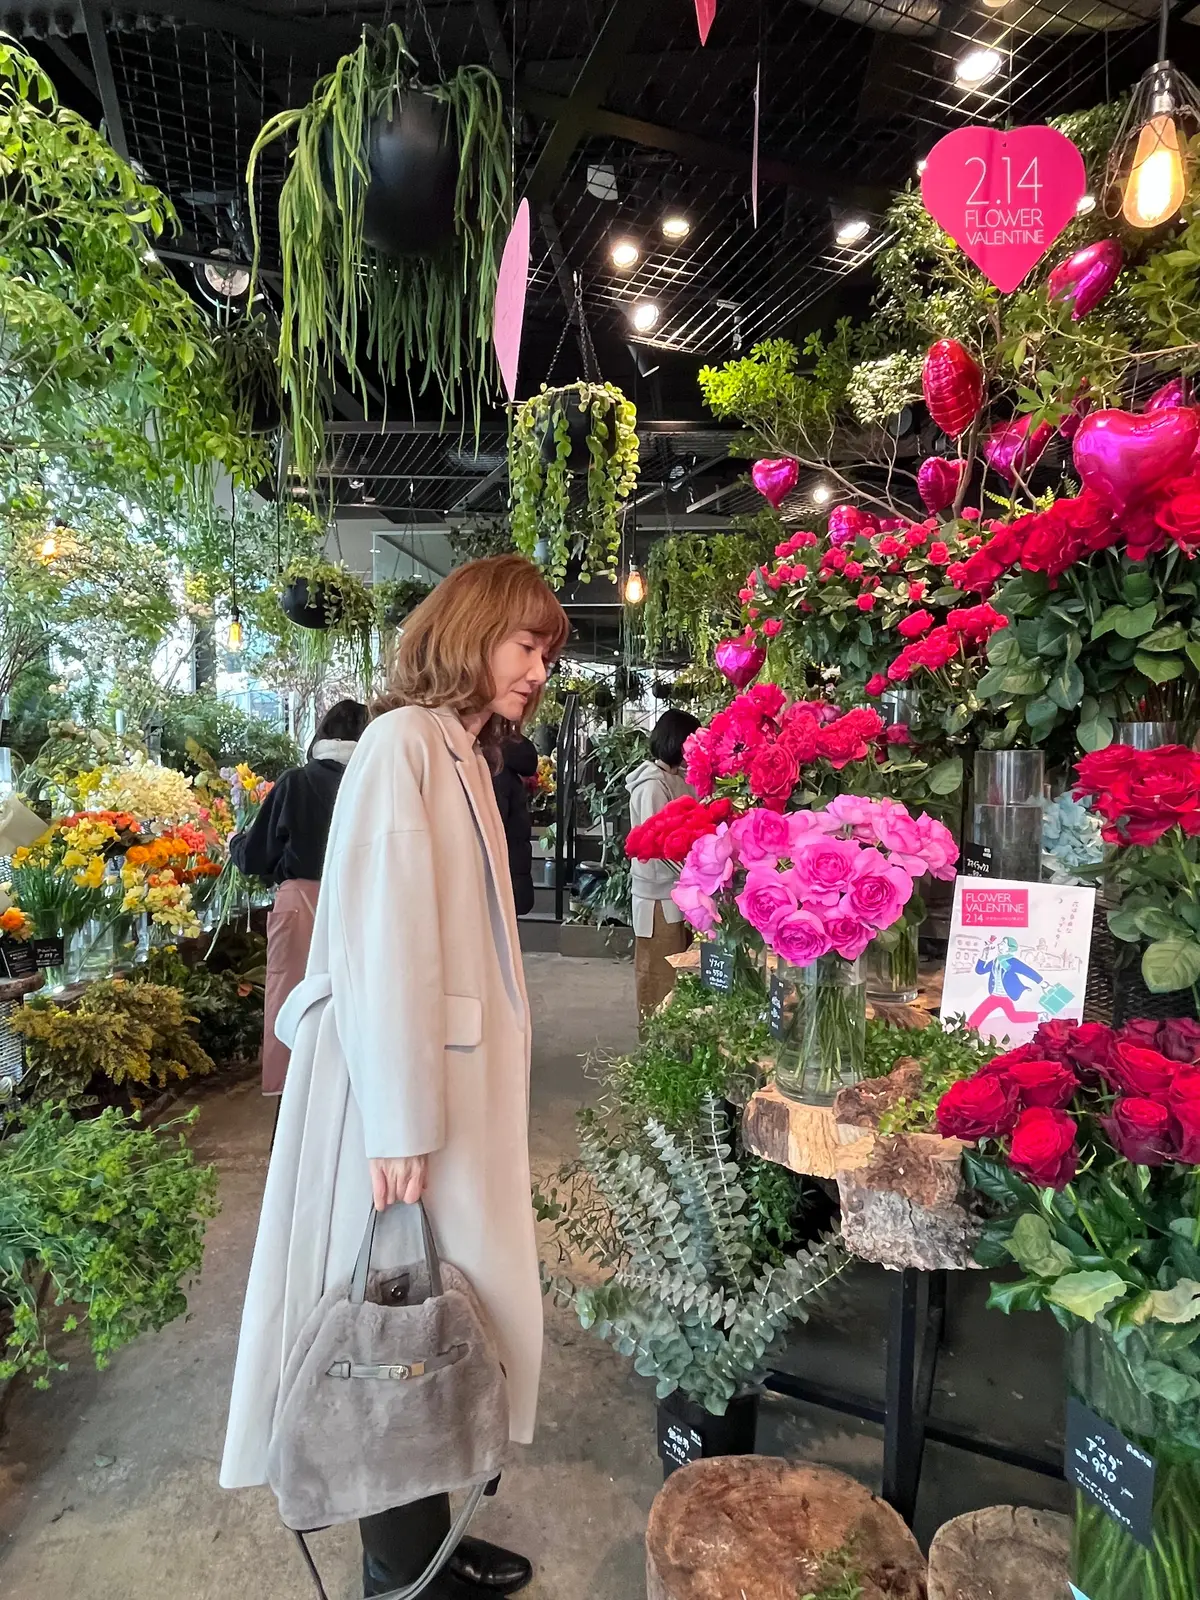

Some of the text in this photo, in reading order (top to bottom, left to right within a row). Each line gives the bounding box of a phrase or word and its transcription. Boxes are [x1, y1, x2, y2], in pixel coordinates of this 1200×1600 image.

[964, 156, 1043, 205] 2.14
[965, 208, 1044, 228] FLOWER
[966, 230, 1044, 246] VALENTINE
[965, 893, 1012, 903] FLOWER
[965, 903, 1024, 914] VALENTINE
[672, 1443, 686, 1459] 990
[1091, 1457, 1117, 1483] 990
